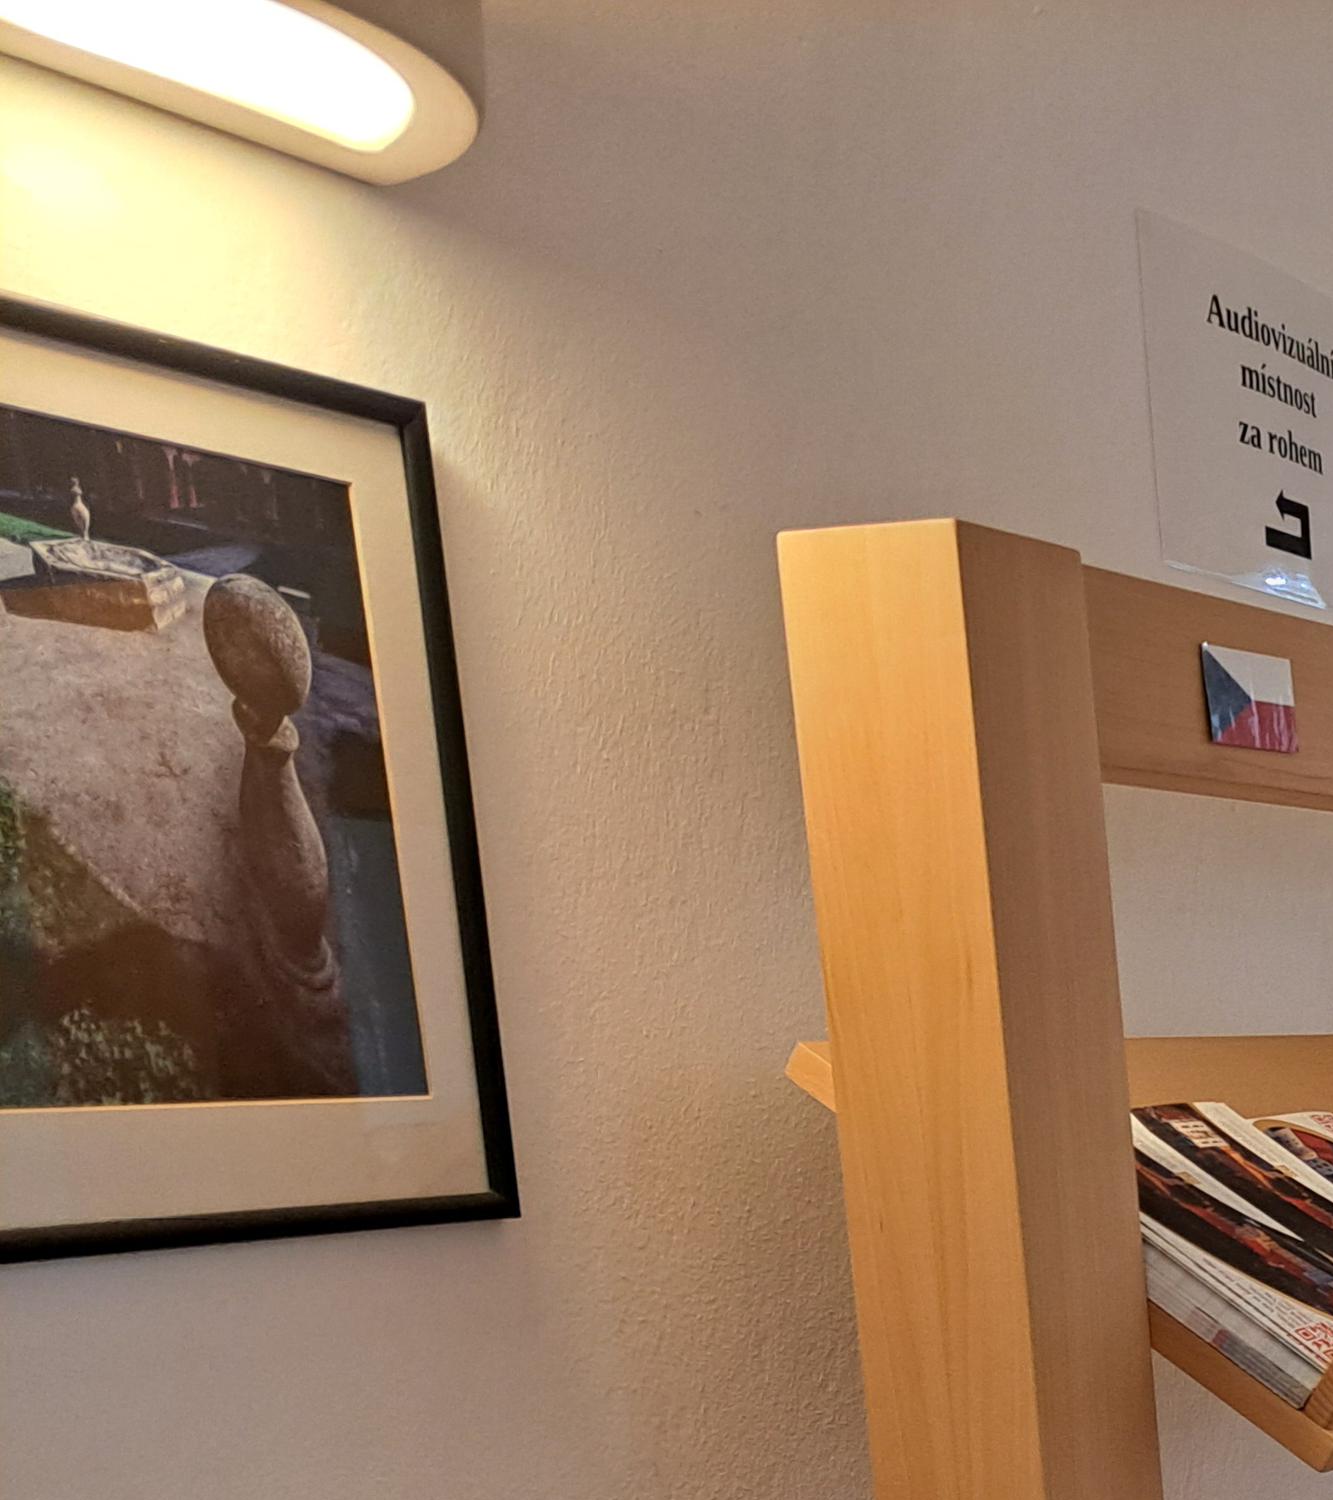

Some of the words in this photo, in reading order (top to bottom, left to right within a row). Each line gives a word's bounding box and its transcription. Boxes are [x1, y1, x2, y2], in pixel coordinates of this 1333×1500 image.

[1240, 363, 1317, 418] místnost
[1238, 419, 1262, 449] za
[1268, 429, 1324, 475] rohem
